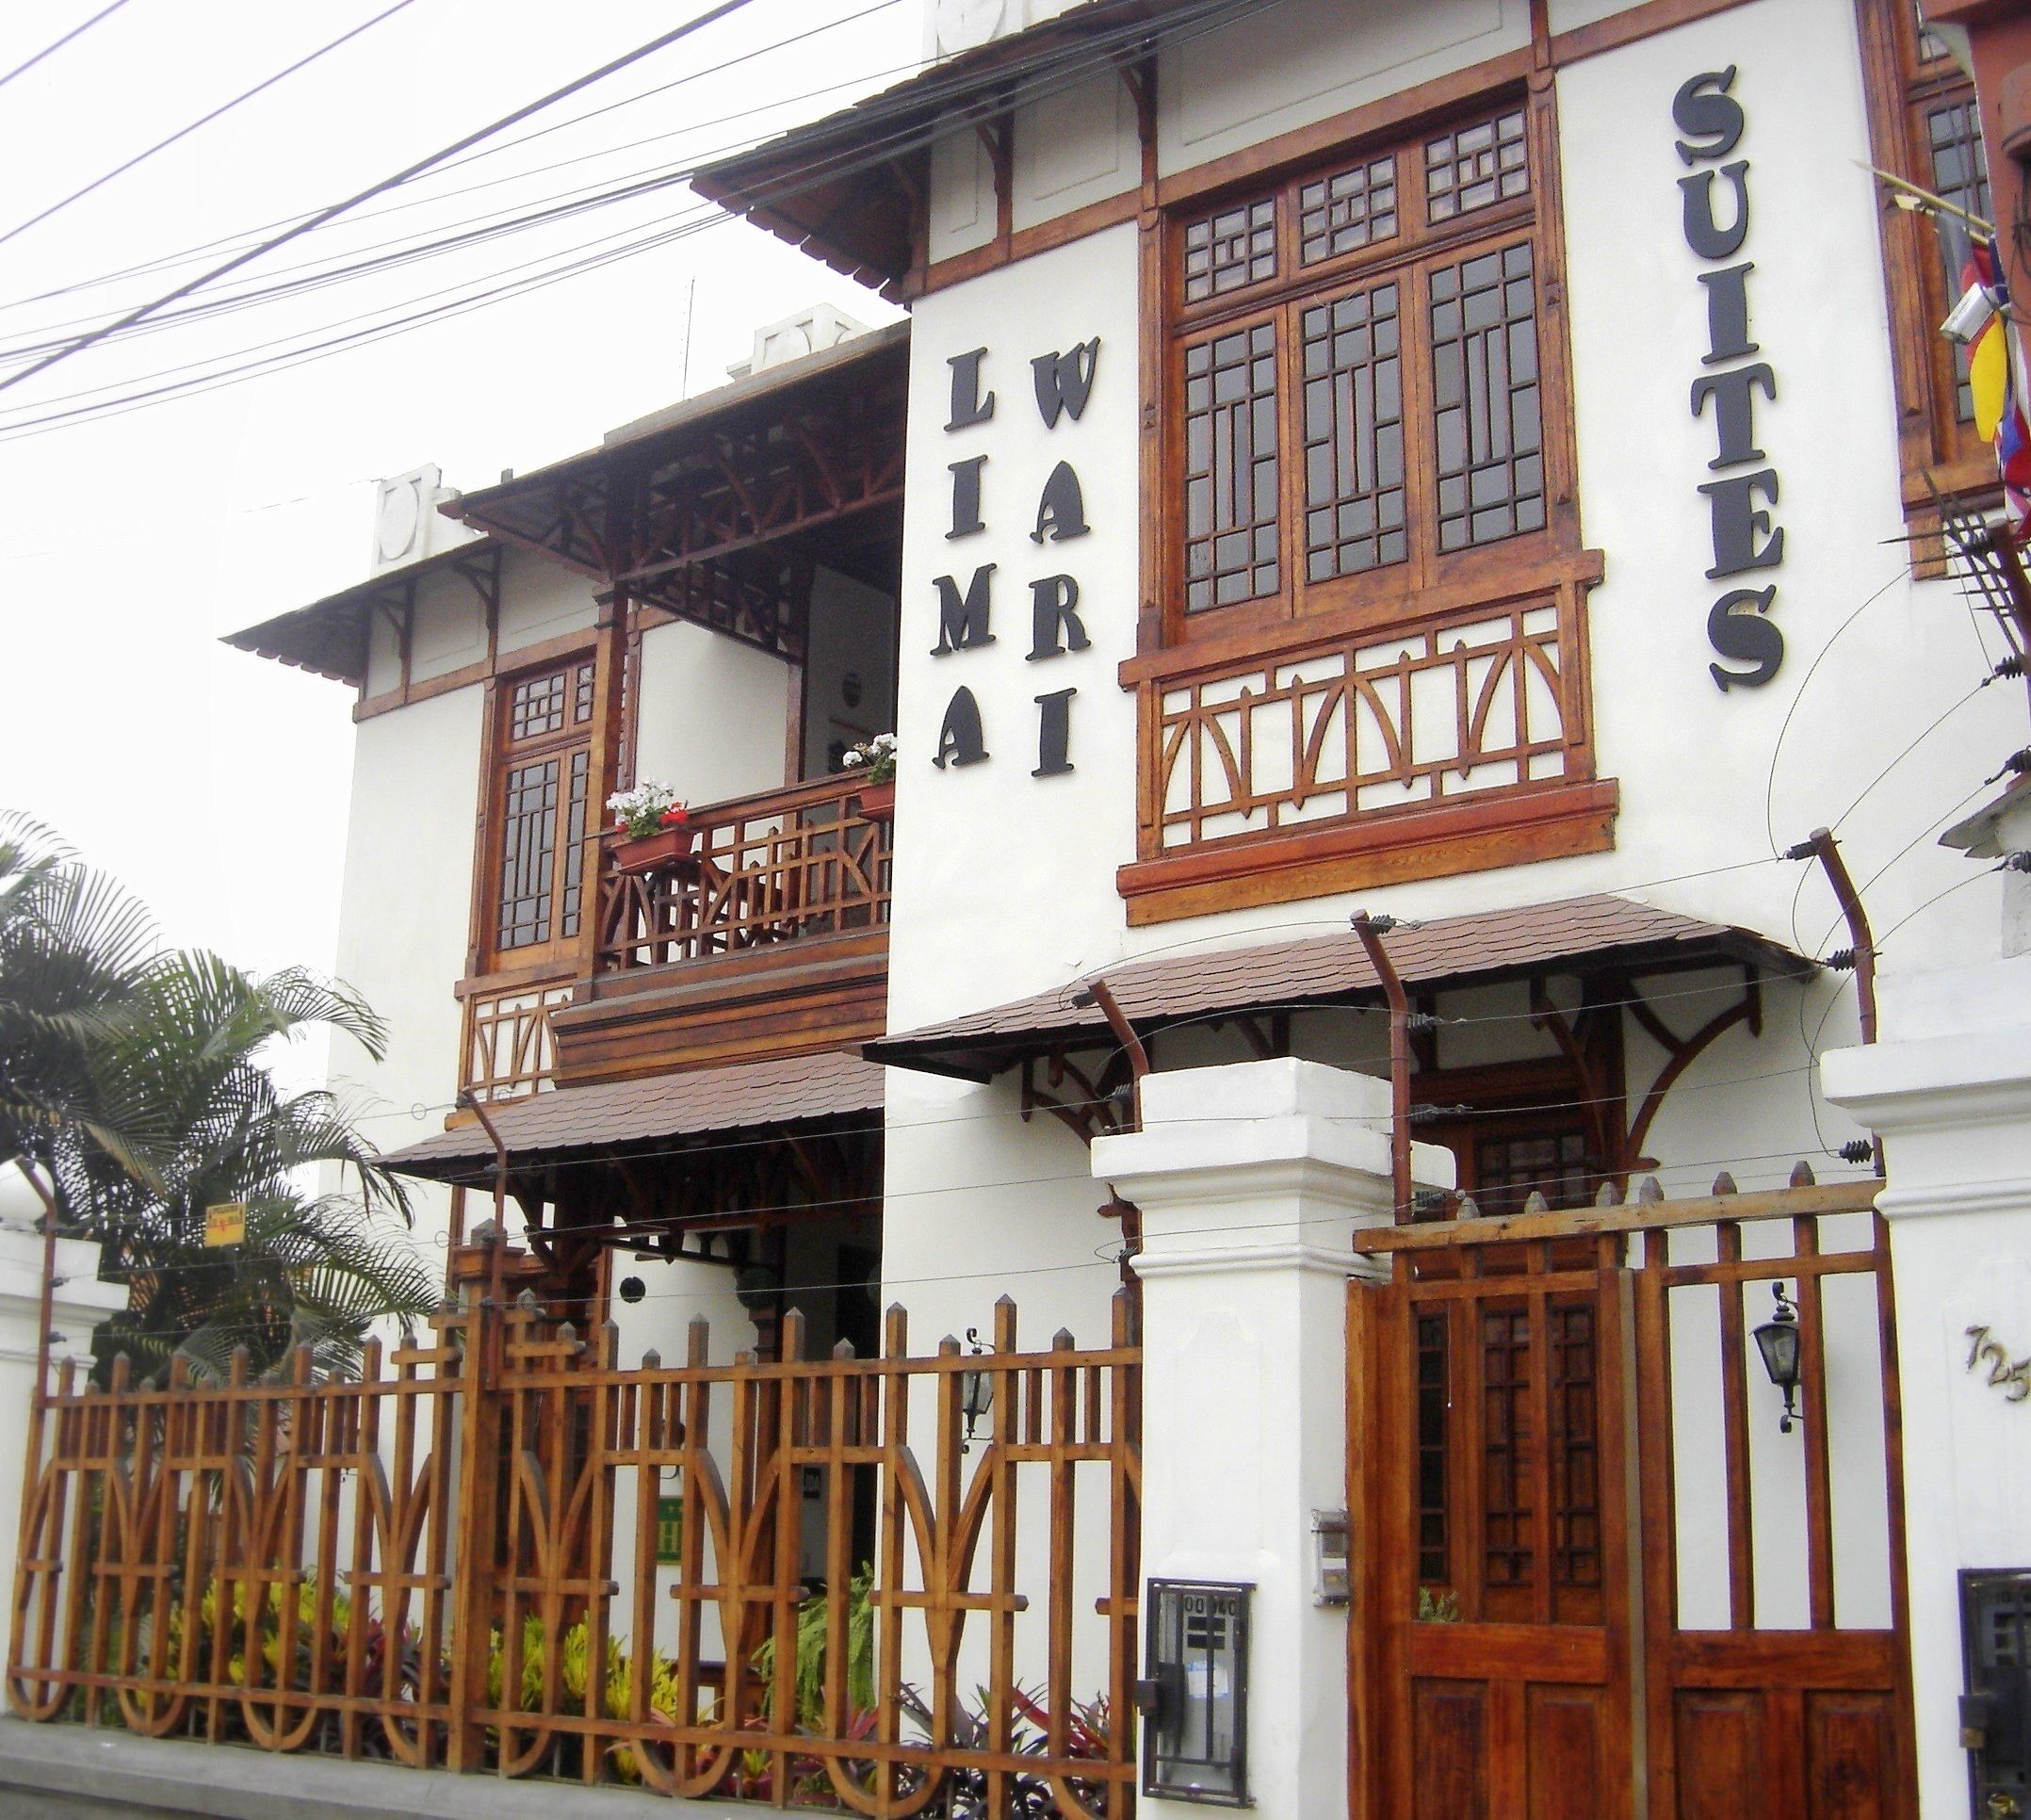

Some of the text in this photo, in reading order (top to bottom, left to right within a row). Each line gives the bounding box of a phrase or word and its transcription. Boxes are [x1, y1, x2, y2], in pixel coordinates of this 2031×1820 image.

[930, 346, 998, 771] LIMA
[1025, 335, 1101, 778] WARI
[1672, 63, 1784, 693] SUITES
[1964, 1324, 2031, 1402] 725
